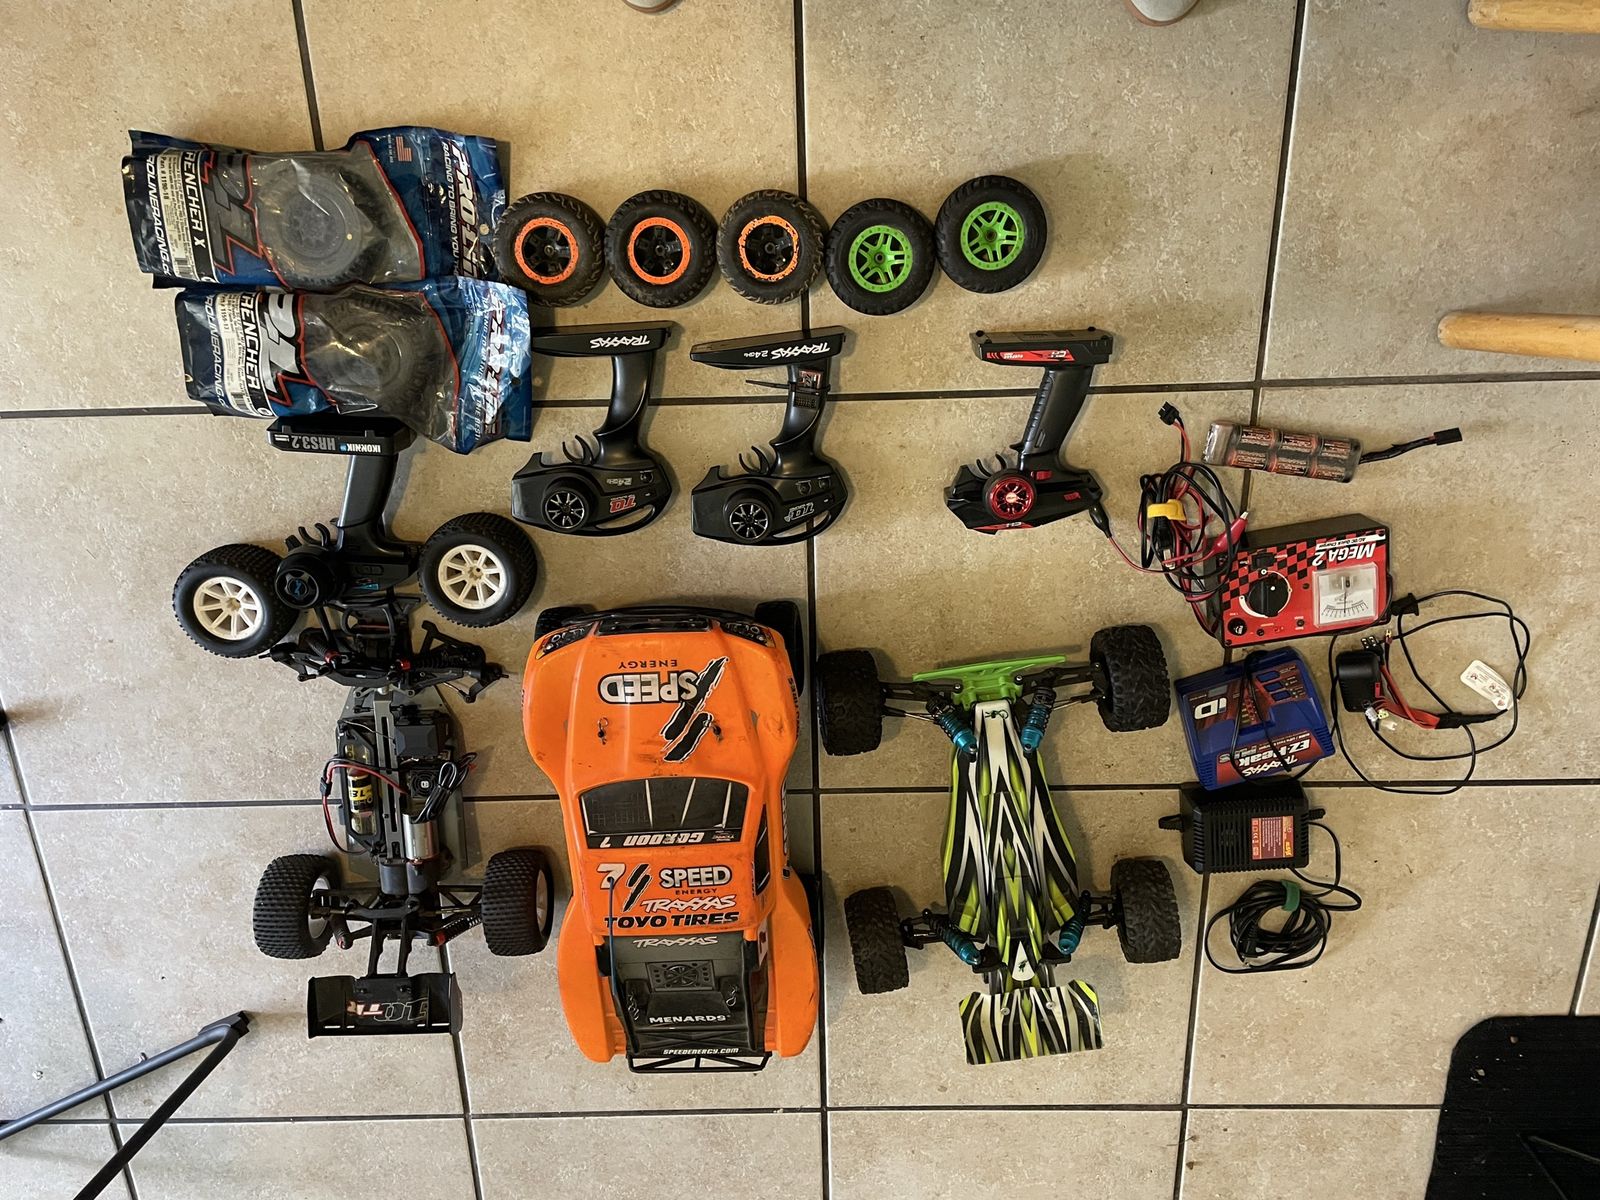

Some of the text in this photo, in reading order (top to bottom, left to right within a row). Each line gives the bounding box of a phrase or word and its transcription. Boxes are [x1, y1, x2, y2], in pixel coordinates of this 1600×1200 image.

[442, 143, 456, 182] RACING
[183, 152, 206, 248] RENCHER X
[447, 184, 455, 199] TO
[146, 155, 171, 276] ROLINERACING.c
[448, 142, 478, 277] PRO-LIN
[449, 200, 457, 233] BRING
[240, 294, 260, 389] RENCHER
[590, 334, 650, 348] TRAXXAS
[770, 342, 830, 360] TRAXXAS
[291, 435, 336, 450] HRS3.2
[1310, 542, 1376, 567] MEGA 2
[617, 659, 678, 669] ENERGY
[598, 670, 698, 704] SPEED
[599, 837, 611, 848] 7
[596, 863, 626, 890] 7
[659, 865, 732, 889] SPEED
[639, 894, 736, 913] TRAXXAS
[604, 912, 739, 928] TOYO TIRES
[632, 936, 718, 948] TRAXXAS
[649, 1015, 728, 1024] MENARDS
